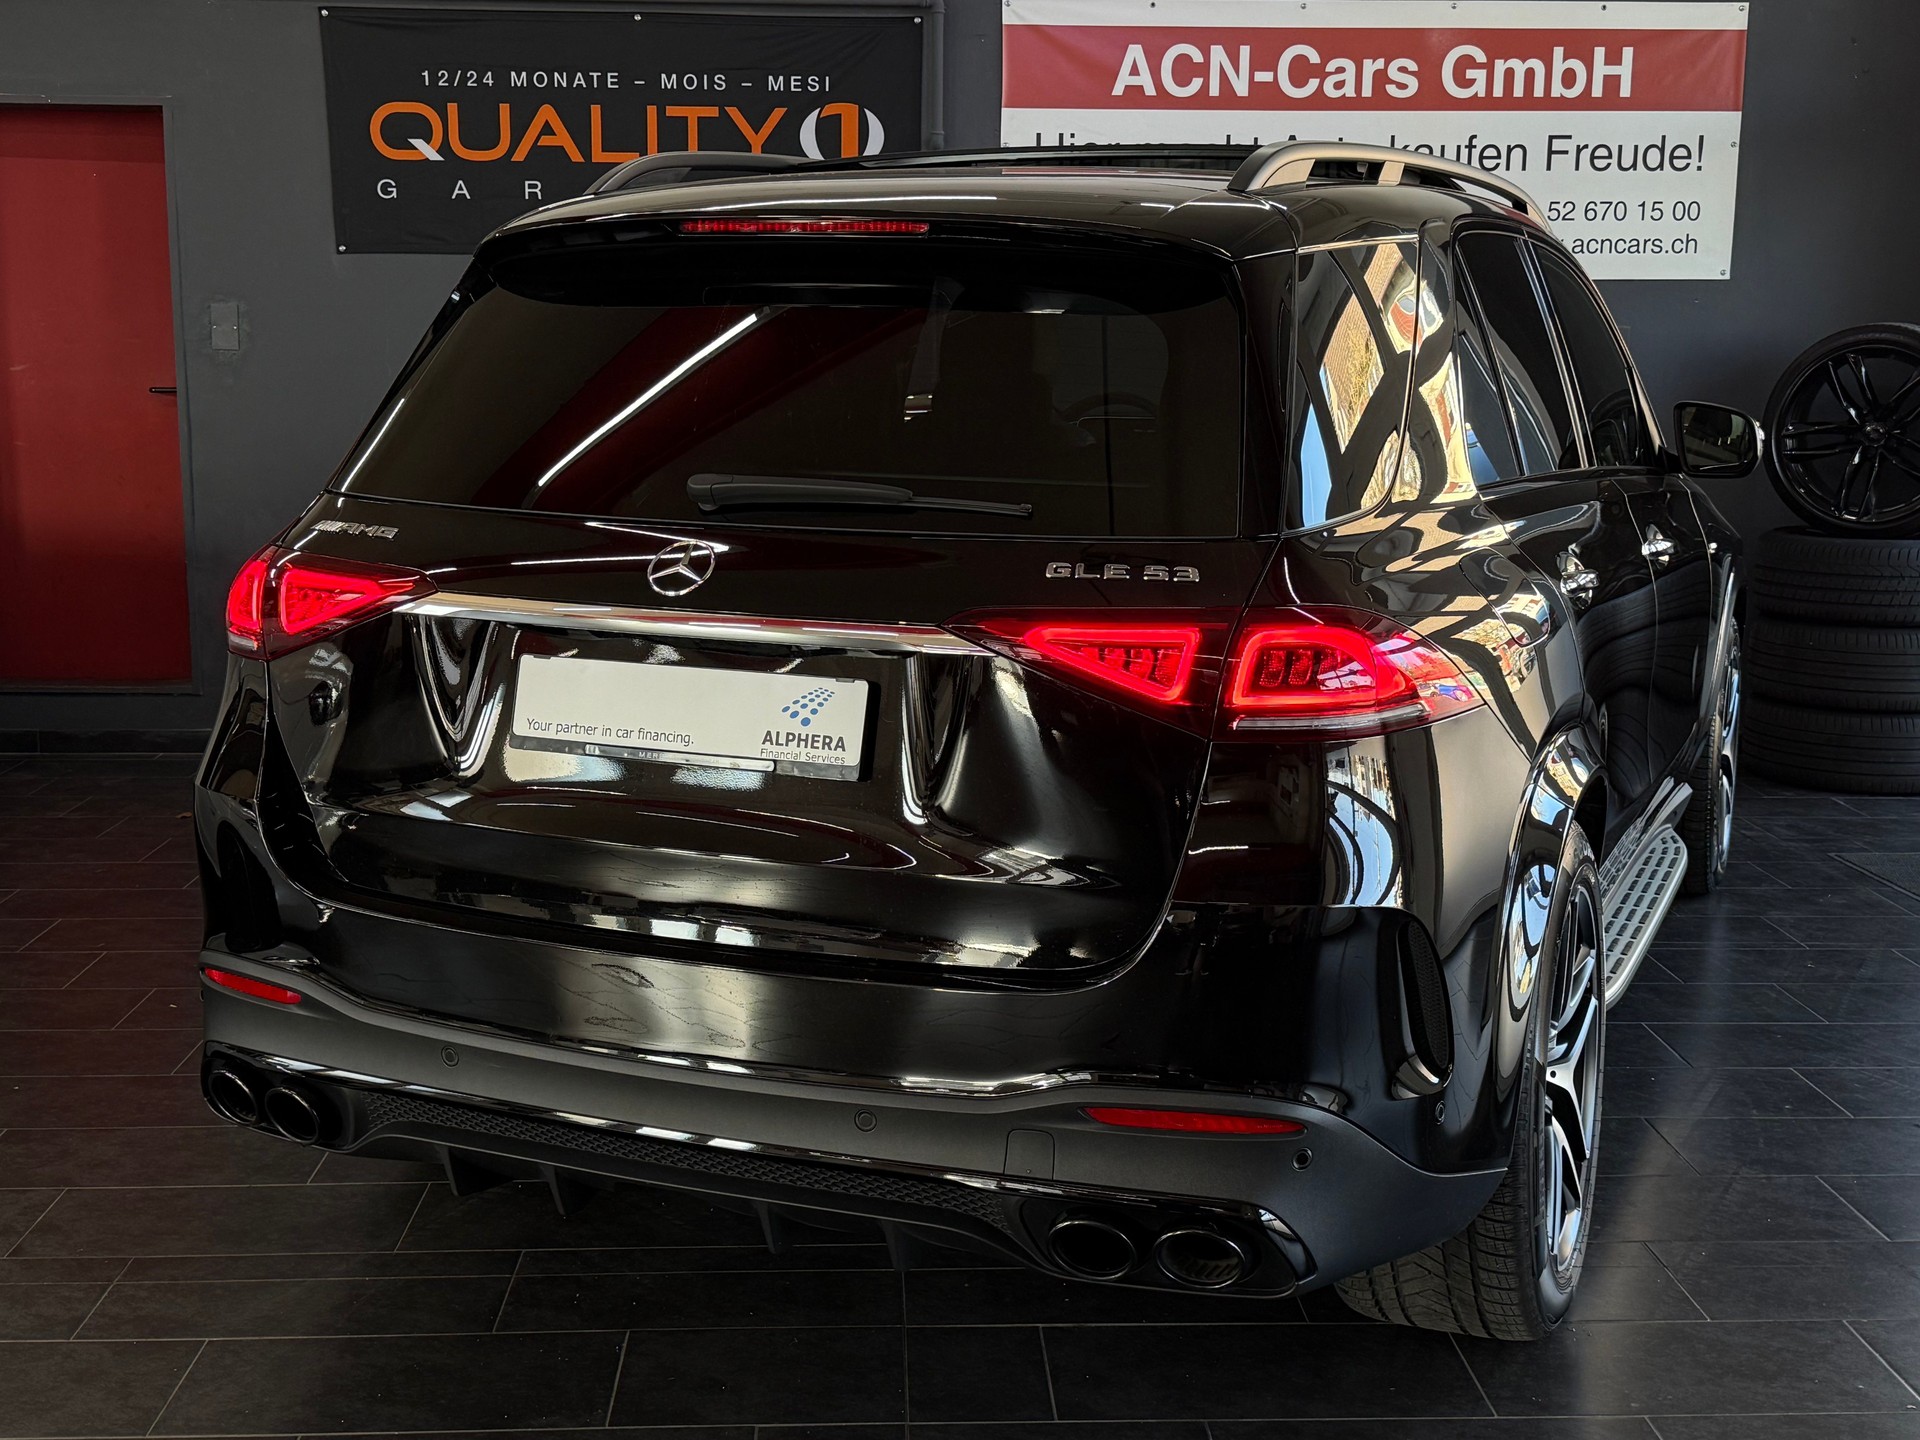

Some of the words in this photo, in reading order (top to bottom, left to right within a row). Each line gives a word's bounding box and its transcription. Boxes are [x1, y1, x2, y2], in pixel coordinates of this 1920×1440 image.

[421, 69, 494, 87] 12/24
[510, 70, 619, 89] MONATE
[660, 73, 726, 91] MOIS
[768, 75, 830, 92] MESI
[1111, 43, 1419, 99] ACN-Cars
[1441, 43, 1634, 99] GmbH
[369, 101, 787, 163] QUALITY
[1545, 134, 1705, 172] Freude!
[376, 178, 542, 200] GAR
[1547, 200, 1576, 221] 52
[1584, 200, 1628, 222] 670
[1637, 200, 1664, 222] 15
[1672, 200, 1701, 222] 00
[1560, 233, 1699, 255] acncars.ch
[1045, 561, 1131, 580] GLE
[1142, 565, 1200, 583] 53
[526, 718, 552, 732] Your
[555, 722, 598, 736] partner
[601, 725, 612, 737] in
[615, 727, 635, 739] car
[637, 728, 694, 747] financing.
[761, 730, 846, 752] ALPHERA
[760, 748, 802, 761] Financial
[805, 751, 846, 765] Services
